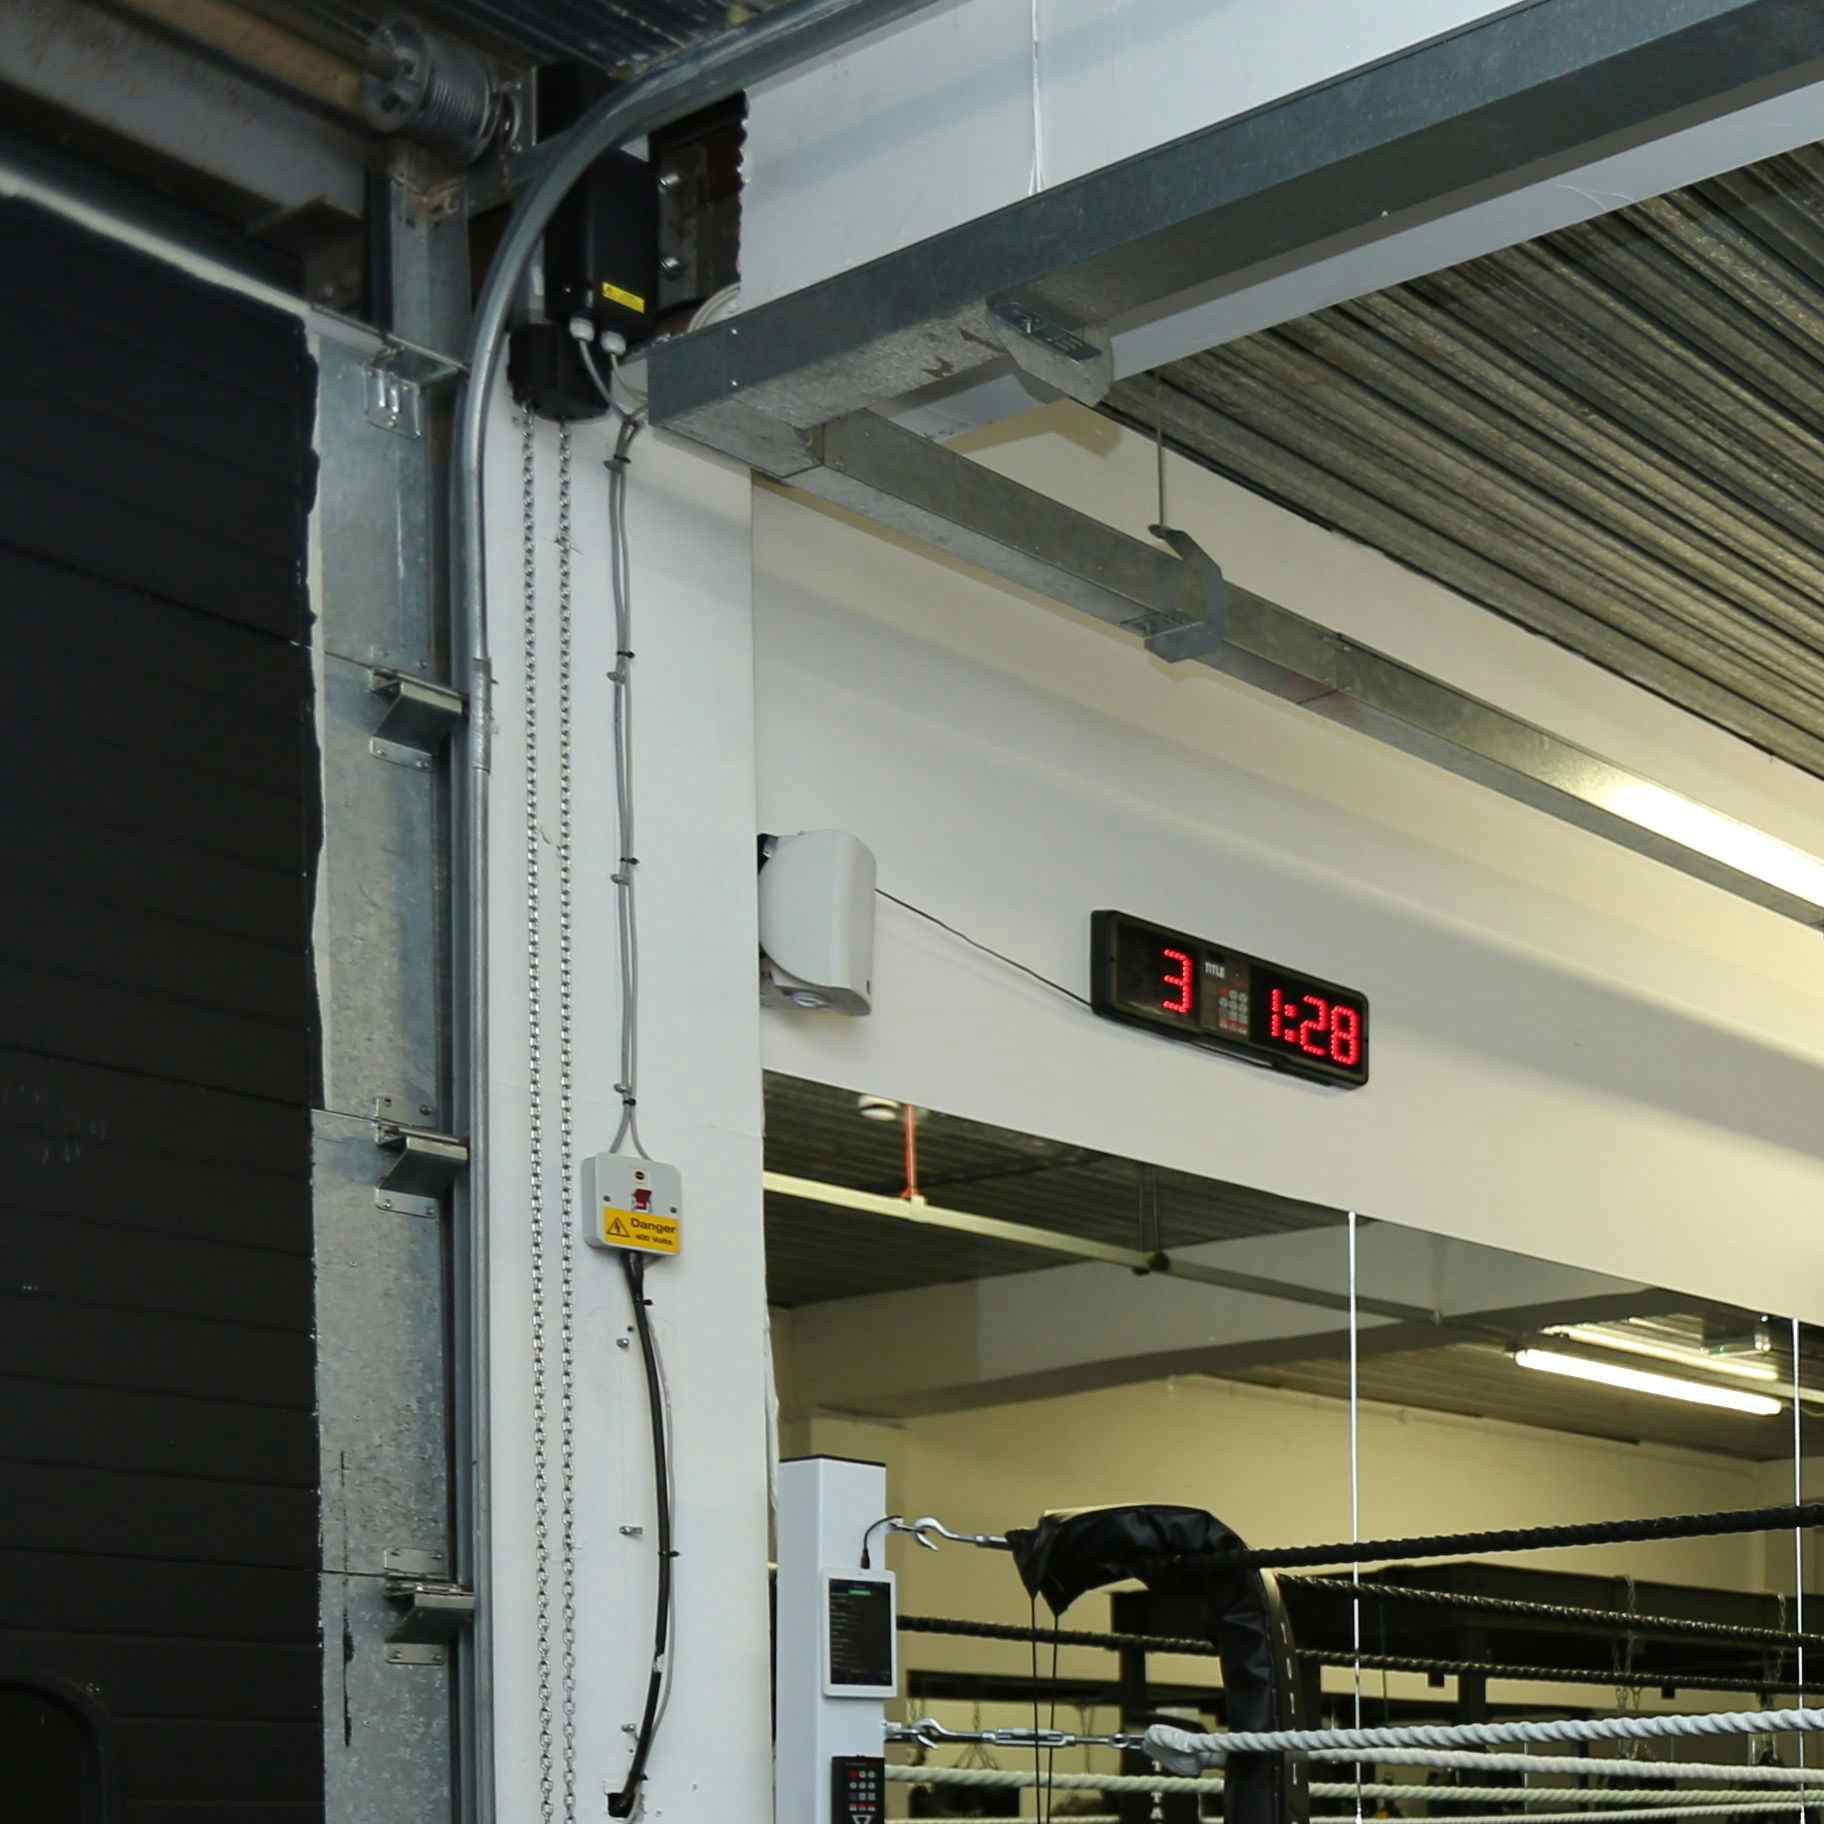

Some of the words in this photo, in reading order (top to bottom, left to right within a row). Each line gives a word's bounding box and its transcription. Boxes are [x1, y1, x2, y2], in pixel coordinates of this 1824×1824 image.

[1162, 948, 1193, 1014] 3
[1271, 988, 1360, 1065] 1:28
[630, 1217, 677, 1234] Danger
